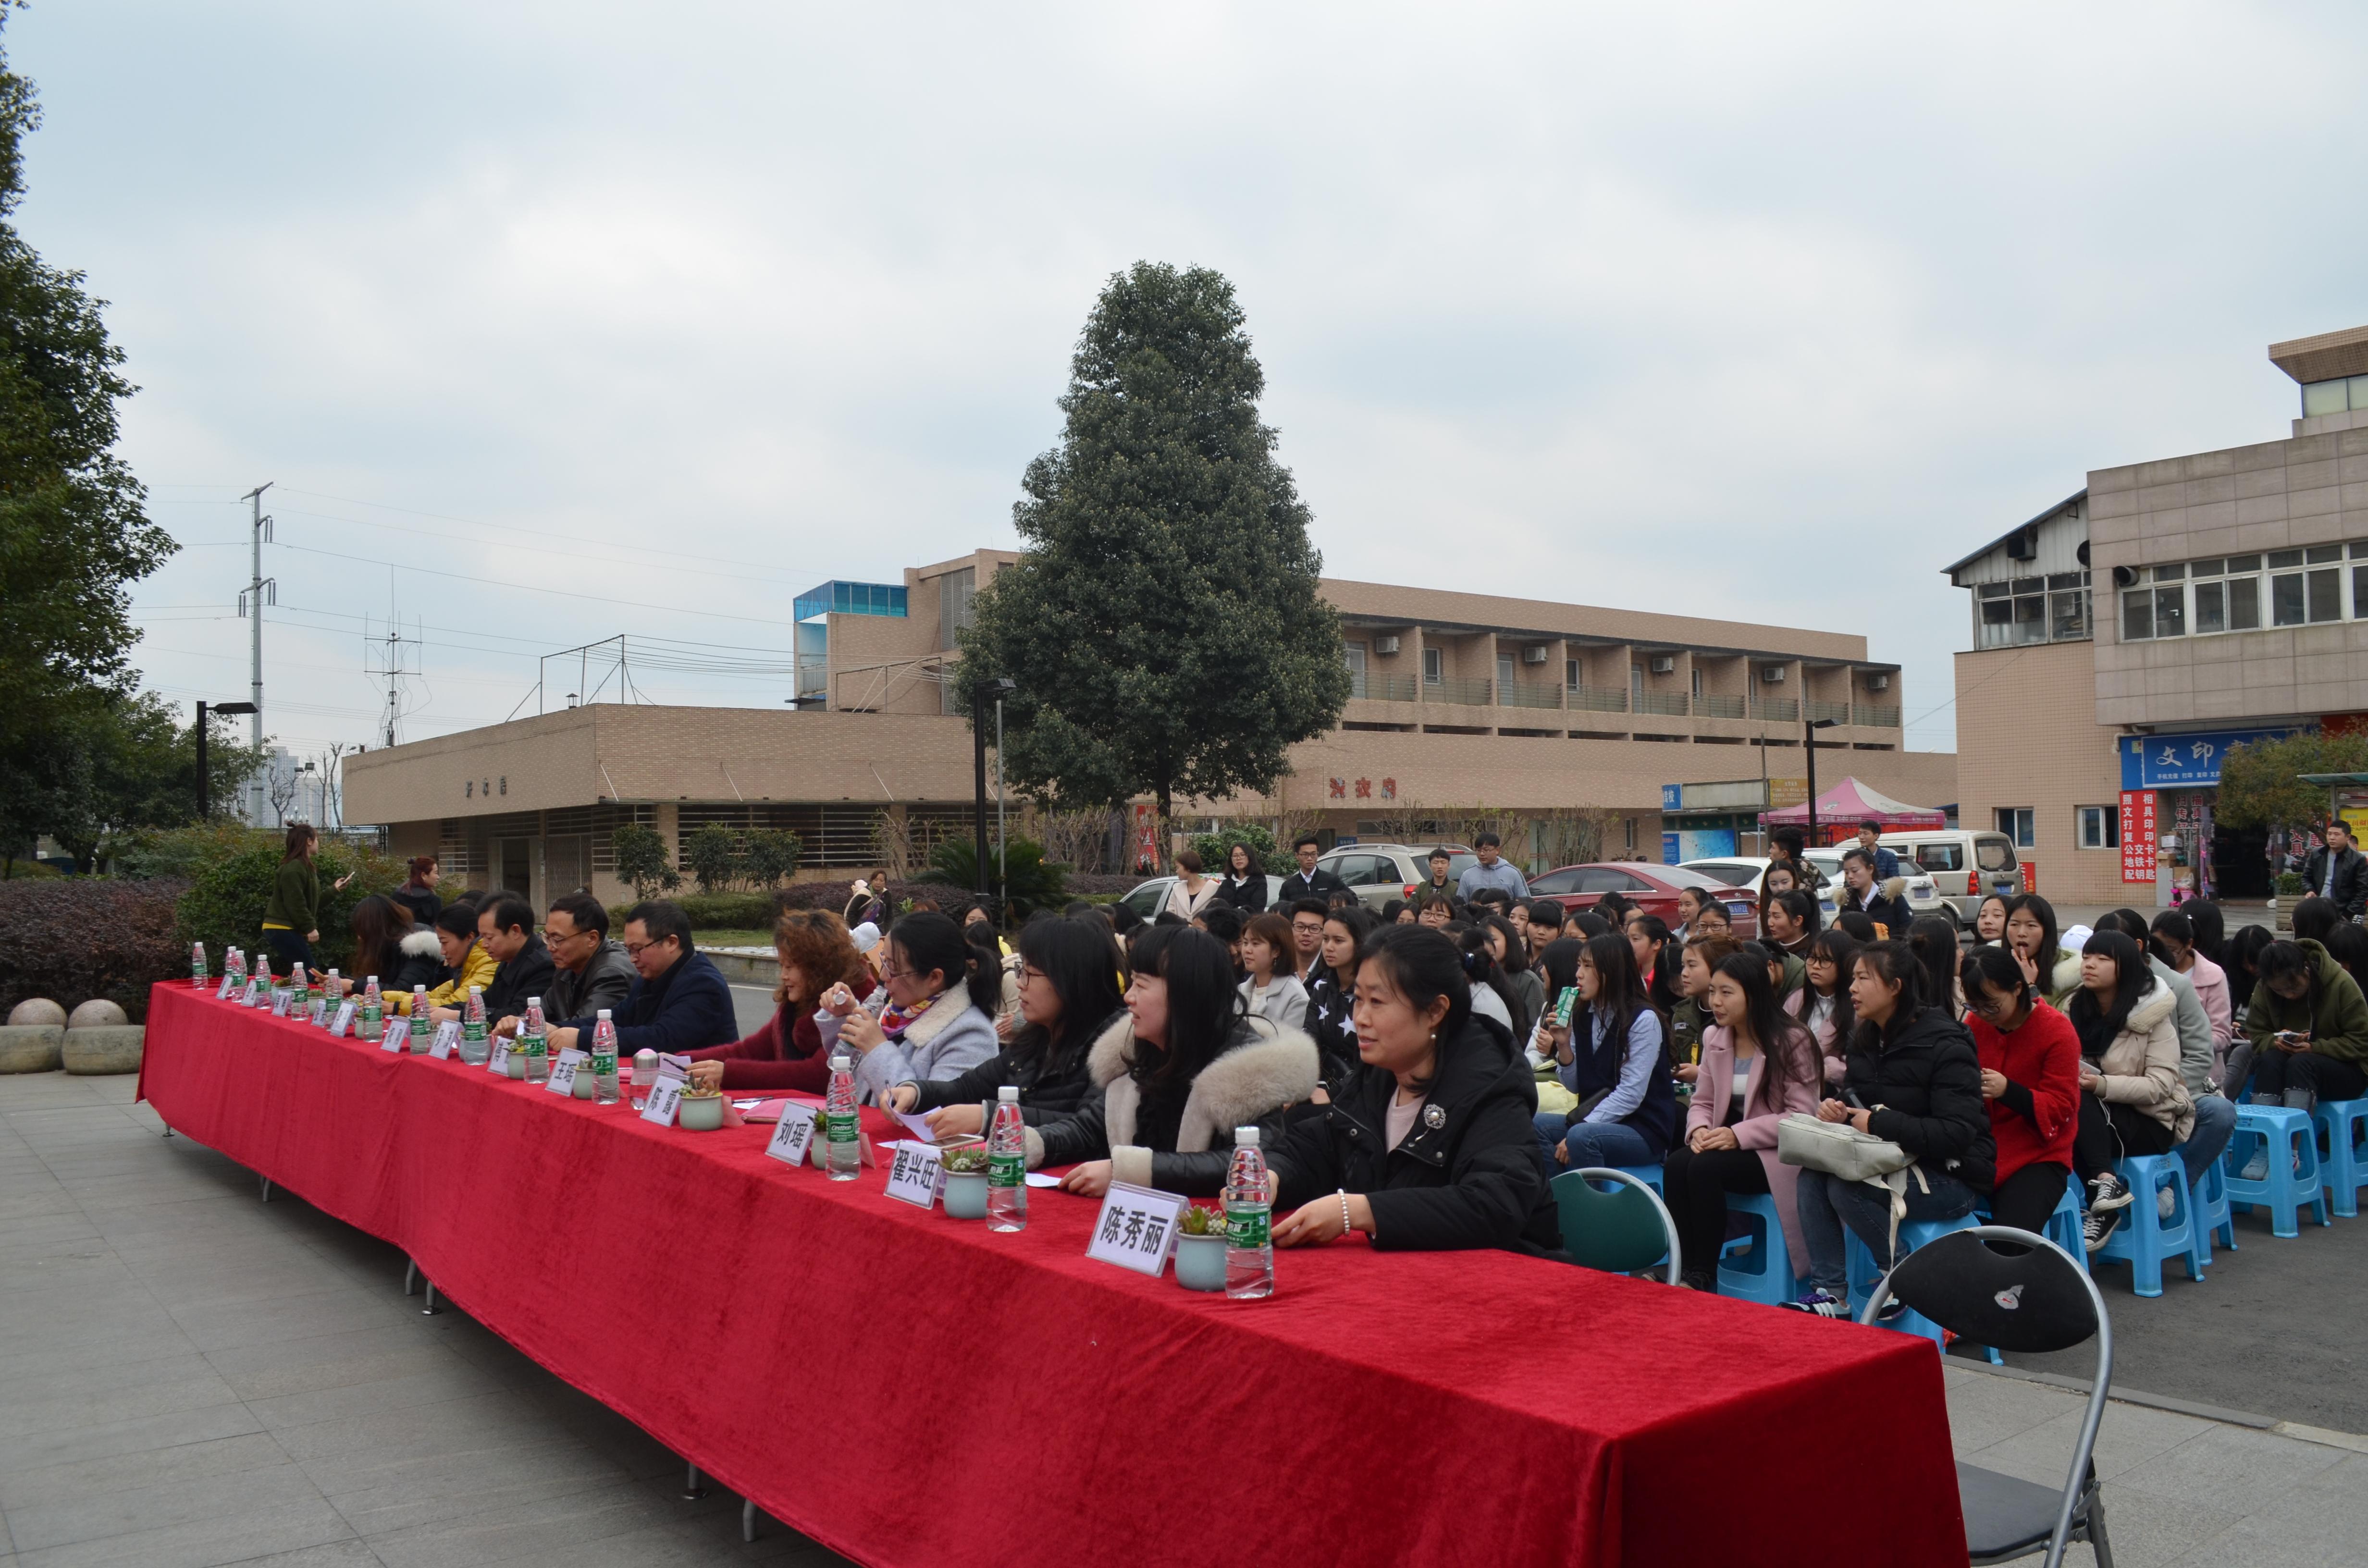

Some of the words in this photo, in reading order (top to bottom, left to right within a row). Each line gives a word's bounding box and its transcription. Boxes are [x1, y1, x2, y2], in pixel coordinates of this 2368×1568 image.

[1330, 776, 1396, 798] 洗衣房
[2123, 794, 2153, 805] 照相
[2175, 795, 2203, 807] 扫描
[2123, 806, 2154, 817] 文具
[2175, 808, 2202, 820] 传真
[2123, 819, 2154, 830] 打印
[2124, 832, 2154, 843] 复印
[2124, 844, 2155, 855] 公交卡
[2124, 857, 2155, 868] 地铁卡
[2125, 869, 2156, 880] 配钥匙
[777, 1119, 808, 1149] 刘瑶
[893, 1149, 937, 1190] 翟兴旺
[1100, 1206, 1169, 1255] 陈秀丽
